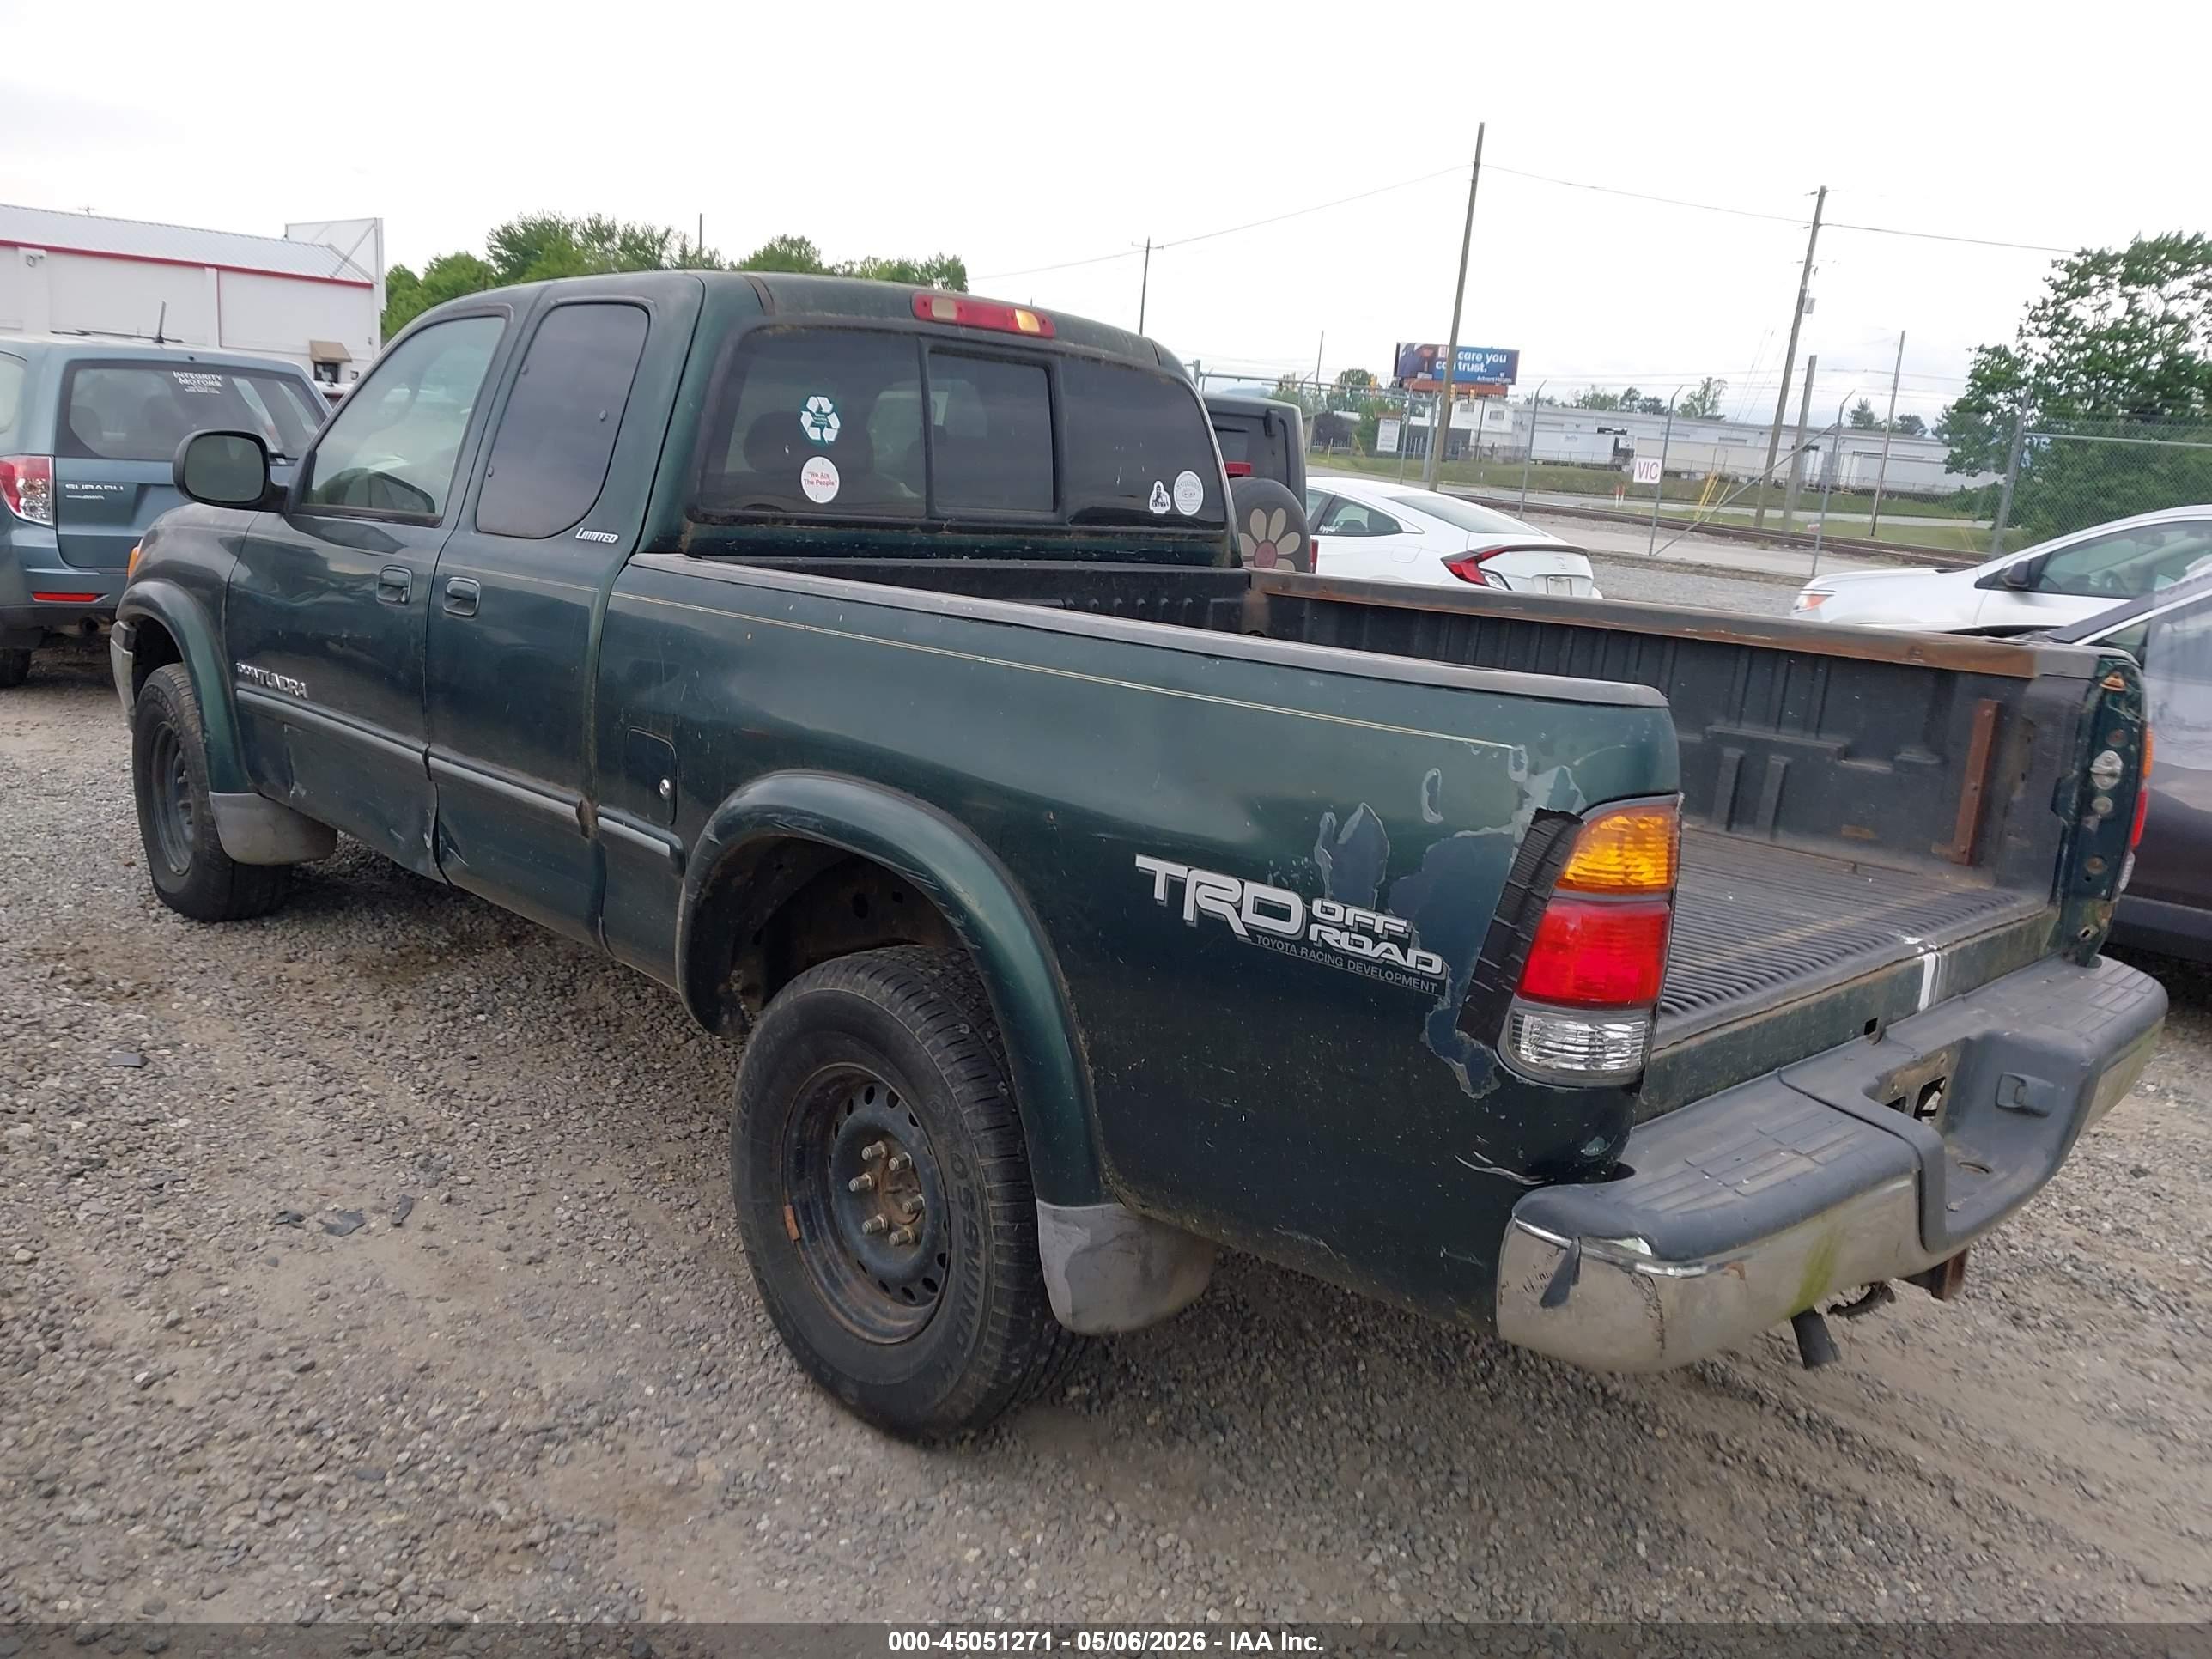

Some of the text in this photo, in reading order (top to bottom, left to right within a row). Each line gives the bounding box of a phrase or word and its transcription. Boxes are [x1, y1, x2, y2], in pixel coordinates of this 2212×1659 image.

[1458, 350, 1483, 361] care
[1486, 353, 1507, 364] you
[1458, 361, 1487, 373] trust.
[179, 378, 222, 387] MOTORS
[1638, 461, 1659, 480] VIC
[65, 483, 124, 492] SUBARU
[575, 527, 618, 544] LIMITED
[257, 668, 307, 699] TUNDRA
[1135, 854, 1304, 939] TRD
[1311, 898, 1411, 935] OFF
[1308, 923, 1446, 978] ROAD
[1256, 934, 1438, 993] TOYOTA RACING DEVELOPMENT
